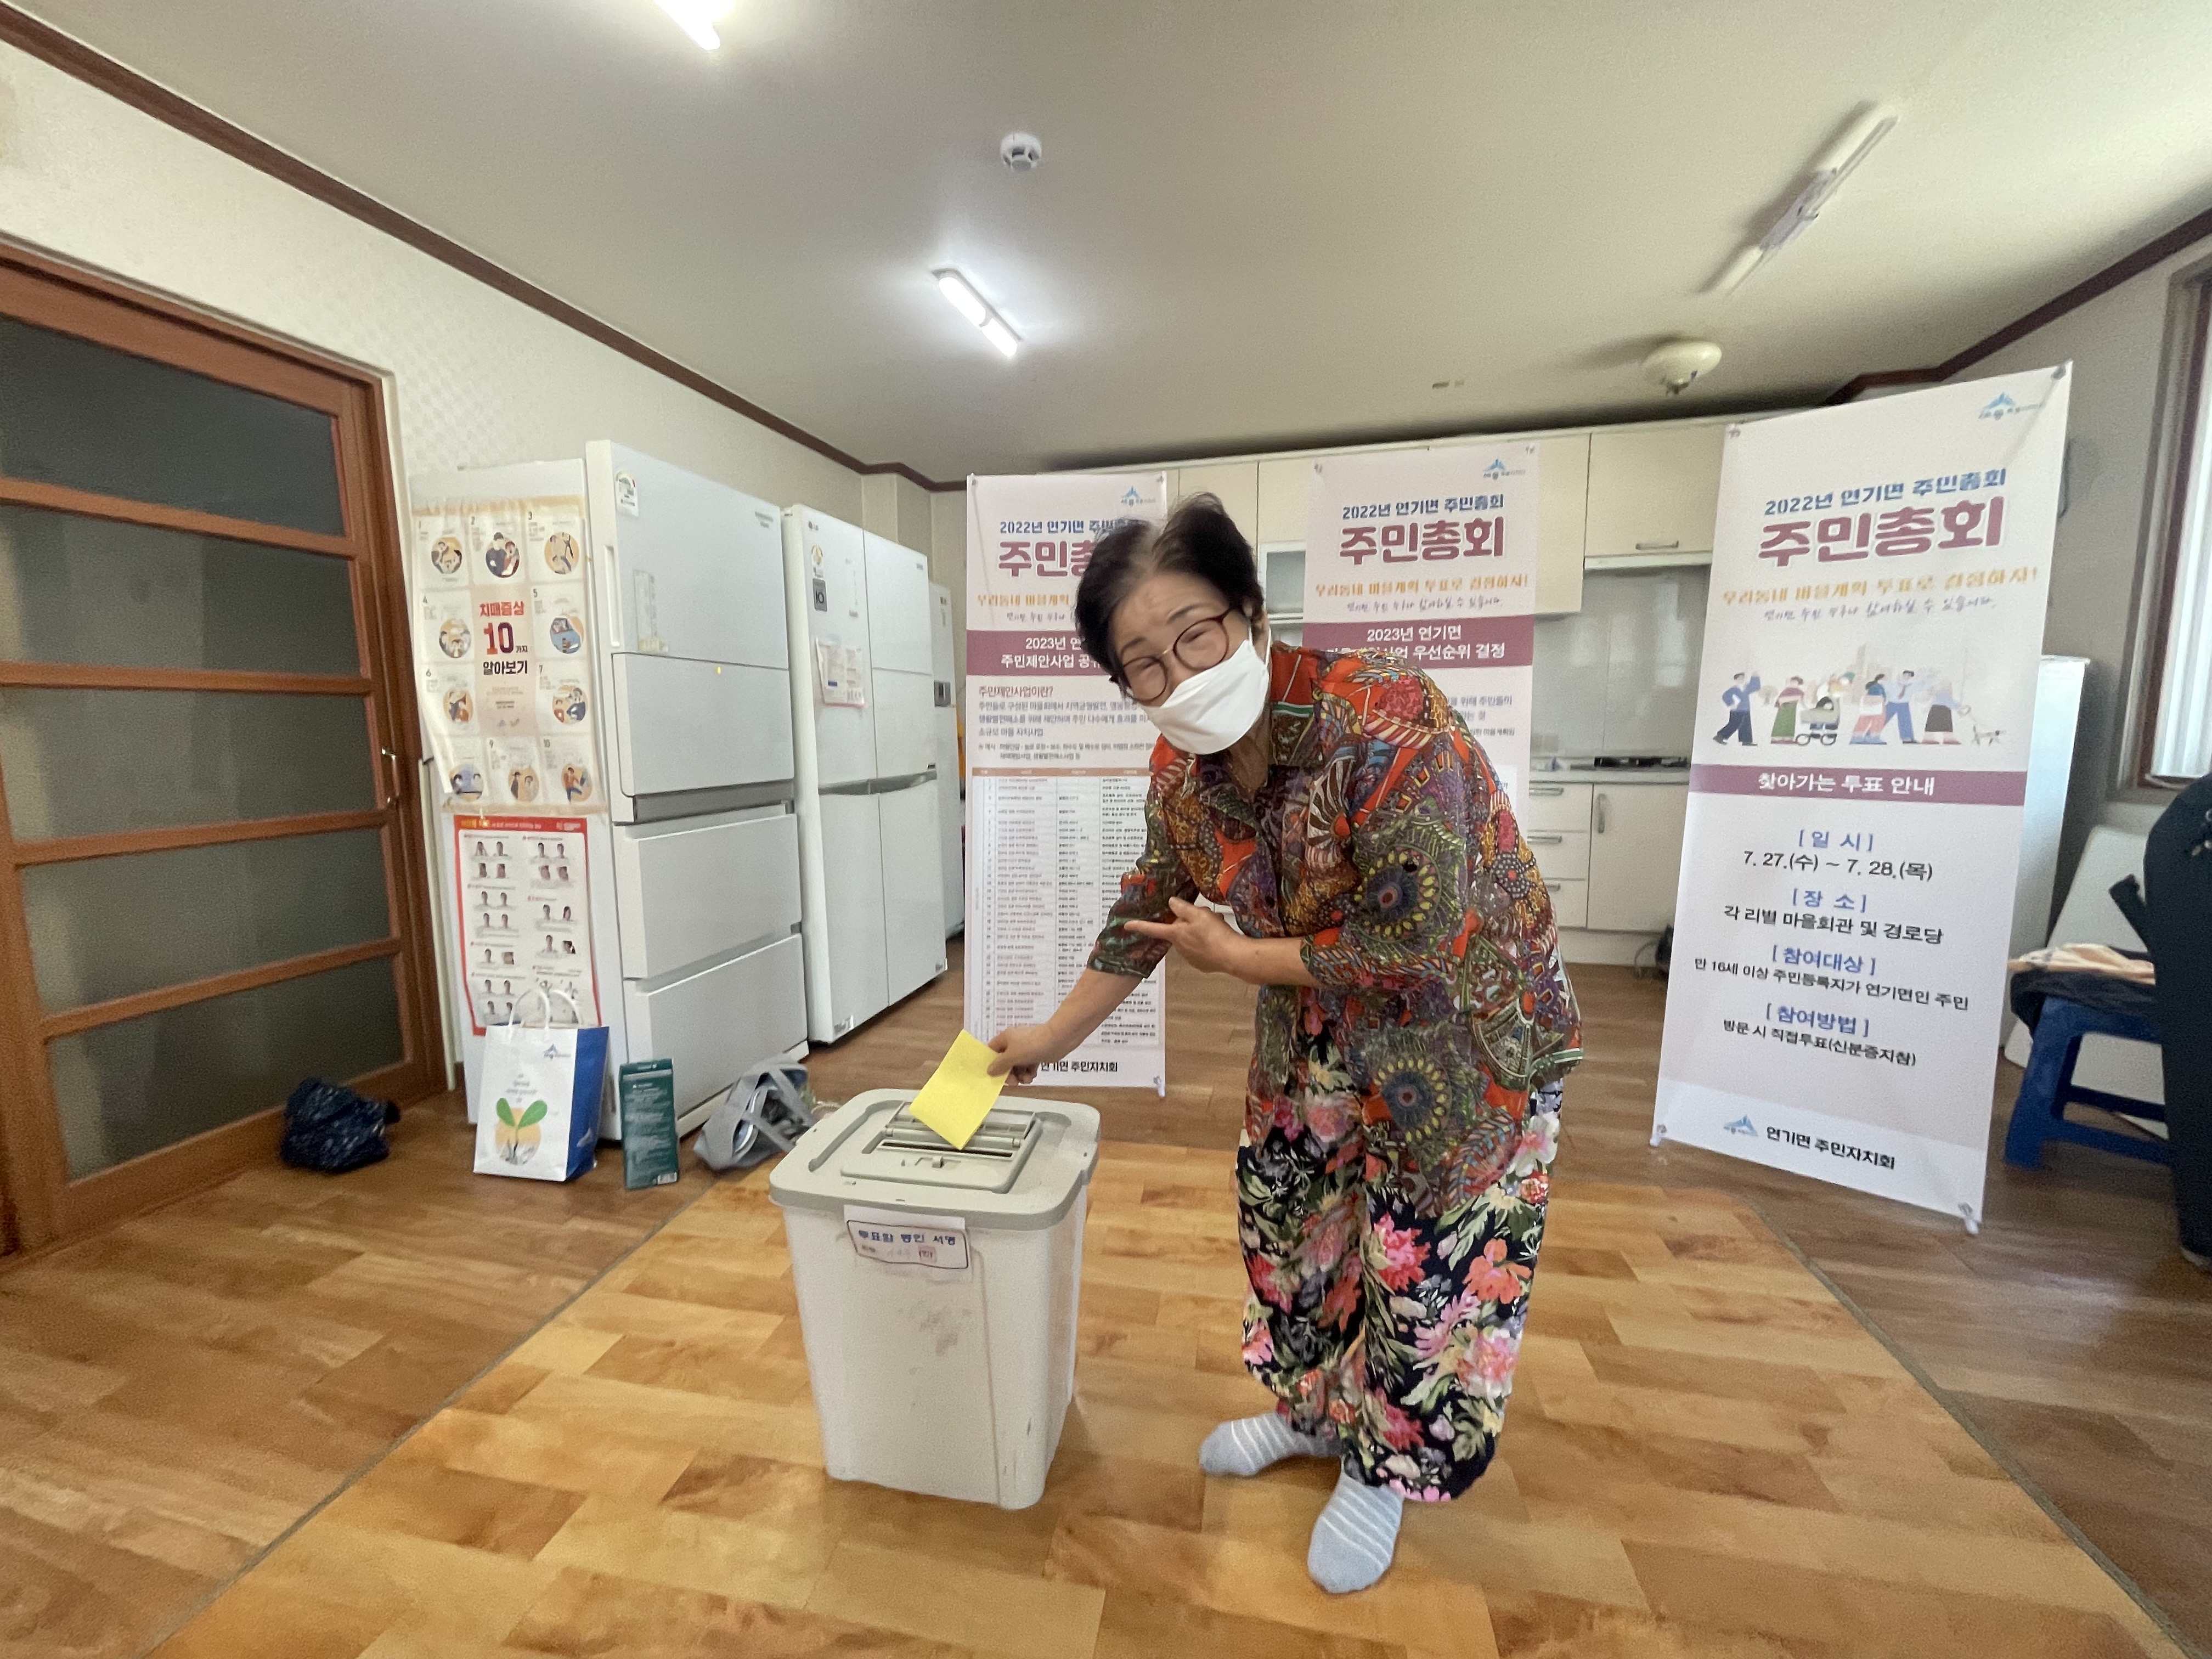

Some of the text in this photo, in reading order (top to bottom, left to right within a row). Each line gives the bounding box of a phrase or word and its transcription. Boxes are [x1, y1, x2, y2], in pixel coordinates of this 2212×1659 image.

[1764, 467, 2006, 516] 2022년 연기면 주민총회
[1342, 494, 1504, 520] 2022년 연기면 주민총회
[1000, 521, 1042, 534] 2022년
[1047, 520, 1084, 534] 연기면
[1758, 496, 2004, 567] 주민총회
[1340, 516, 1504, 565] 주민총회
[998, 540, 1095, 577] 주민총
[479, 601, 524, 617] 치매증상
[483, 622, 514, 654] 10
[1025, 636, 1066, 650] 2023년
[1367, 624, 1462, 642] 2023년 연기면
[1001, 653, 1074, 668] 주민제안사업
[1413, 644, 1471, 661] 우선순위
[1475, 642, 1505, 659] 결정
[483, 660, 528, 675] 알아보기
[979, 686, 1053, 698] 주민제안사업이란?
[1758, 772, 1934, 795] 찾아가는 투표 안내
[1724, 905, 1740, 920] 각
[1783, 912, 1854, 934] 마을회관
[1860, 920, 1877, 937] 및
[1883, 923, 1944, 945] 경로당
[1695, 958, 1968, 1011] 만 16세 이상 주민등록지가 연기면인 주민
[1724, 1019, 1749, 1035] 방문
[1752, 1025, 1767, 1039] 시
[1071, 1060, 1118, 1072] 주민자치회
[1767, 1126, 1895, 1170] 연기면 주민자치회
